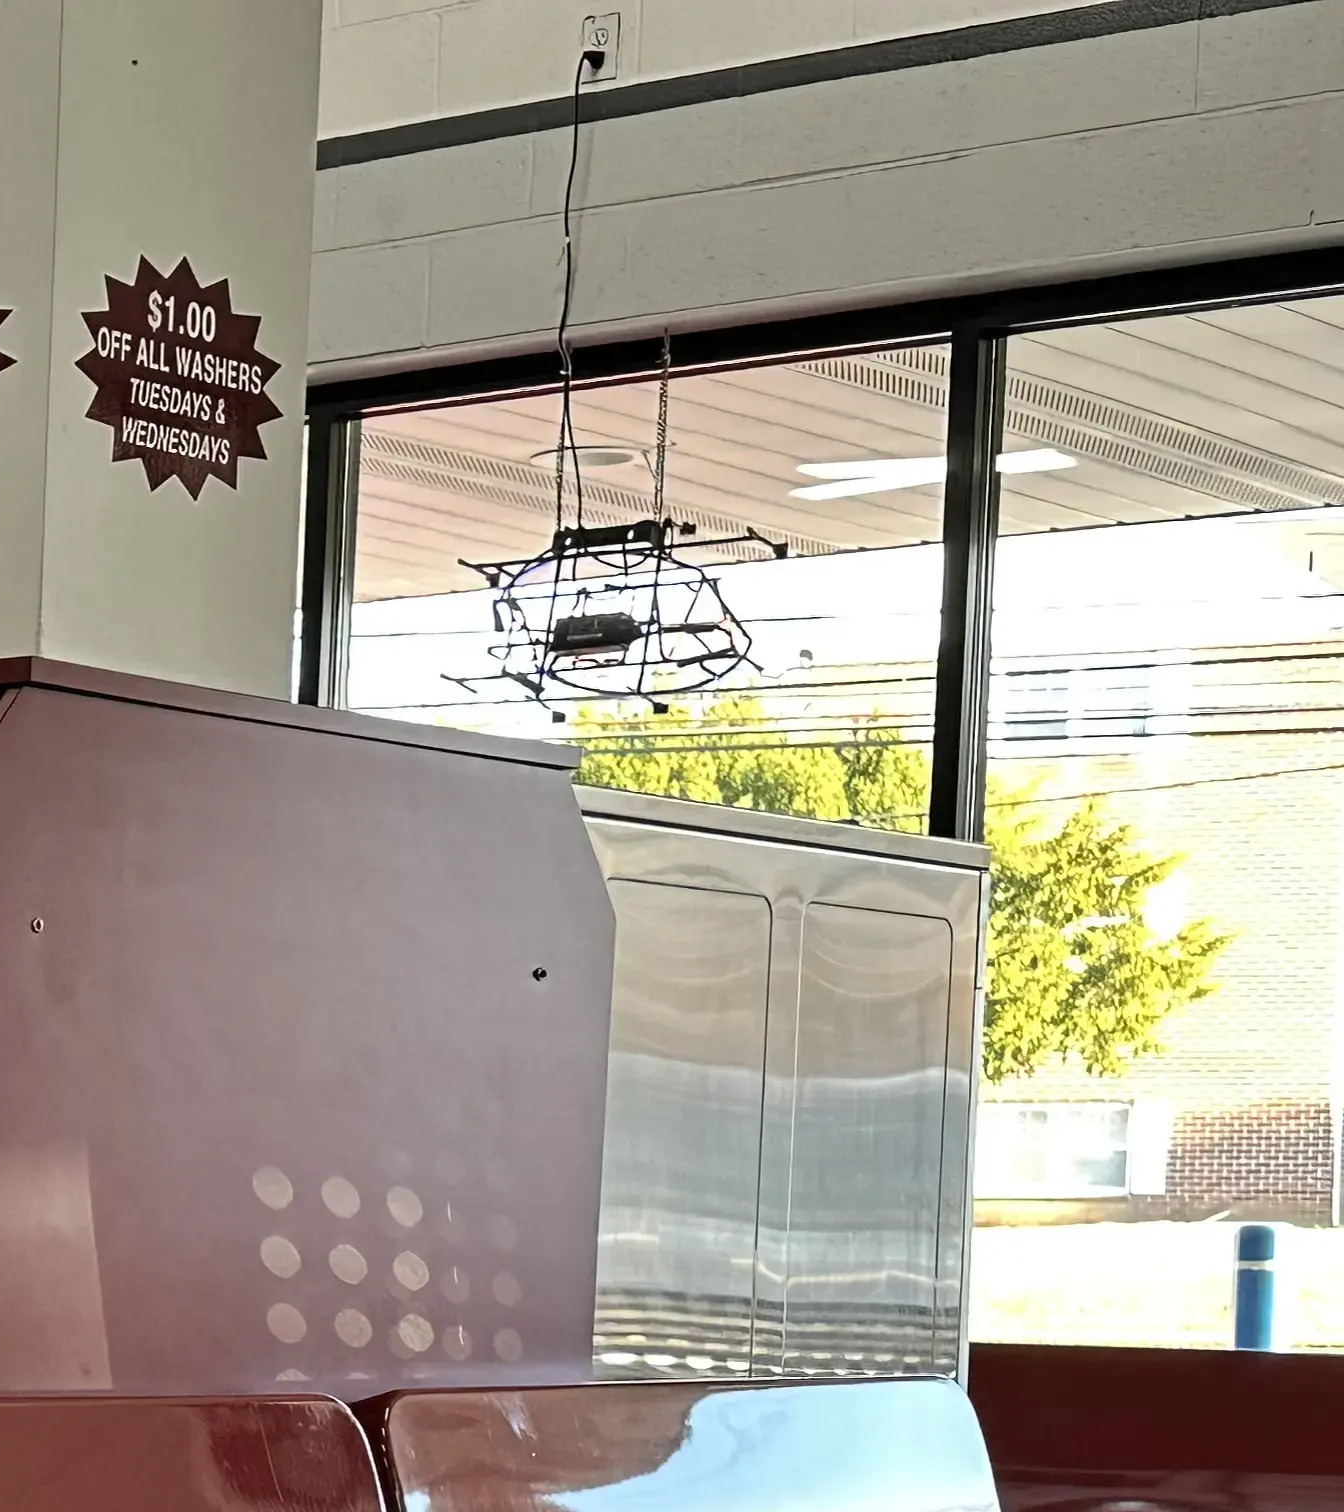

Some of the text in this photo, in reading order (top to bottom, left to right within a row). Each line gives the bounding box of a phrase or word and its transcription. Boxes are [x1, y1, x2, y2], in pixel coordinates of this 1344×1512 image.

[148, 290, 217, 343] $1.00
[97, 326, 263, 395] OFF ALL WASHERS
[129, 377, 226, 425] TUESDAYS &
[122, 414, 231, 465] WEDNESDAYS
